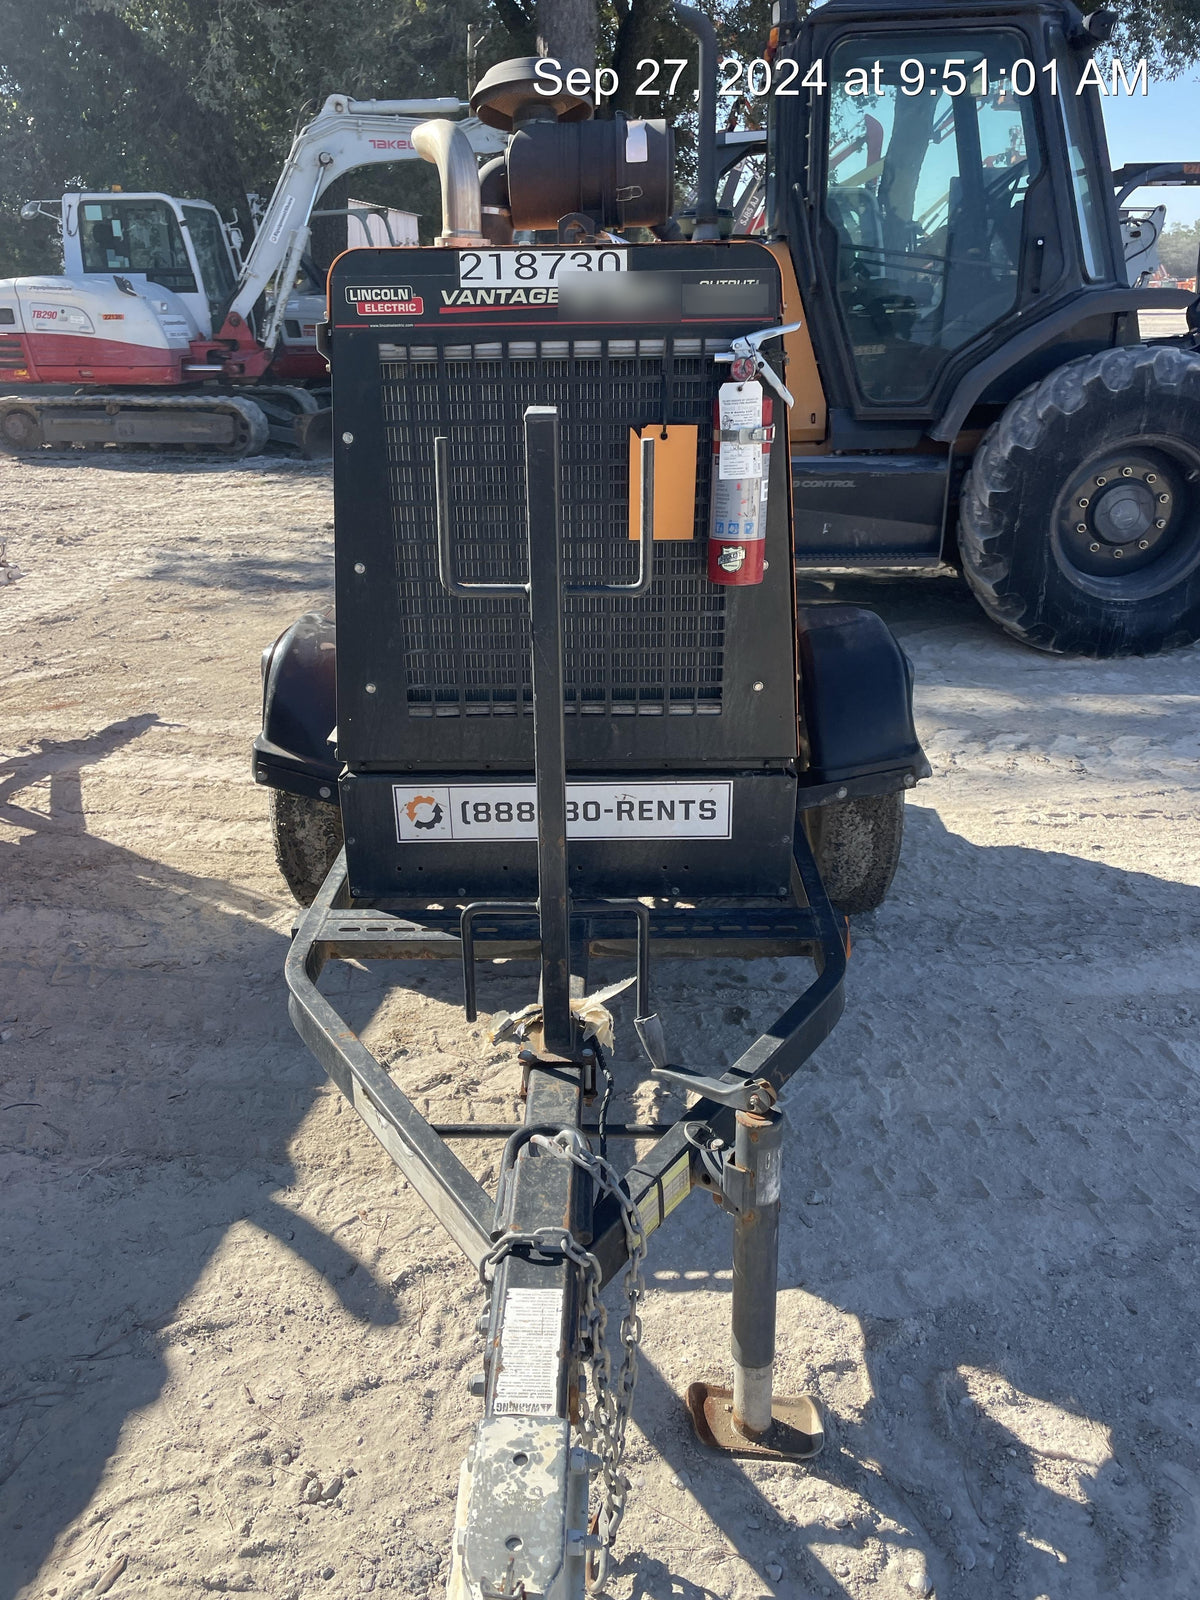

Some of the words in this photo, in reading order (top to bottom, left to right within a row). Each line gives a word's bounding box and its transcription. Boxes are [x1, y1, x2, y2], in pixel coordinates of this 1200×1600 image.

[349, 288, 409, 301] LINCOLN
[440, 288, 559, 305] VANTAGE
[364, 303, 417, 313] ELECTRIC
[32, 309, 58, 320] TB290
[802, 480, 857, 488] CONTROL
[496, 1402, 540, 1413] WARNING
